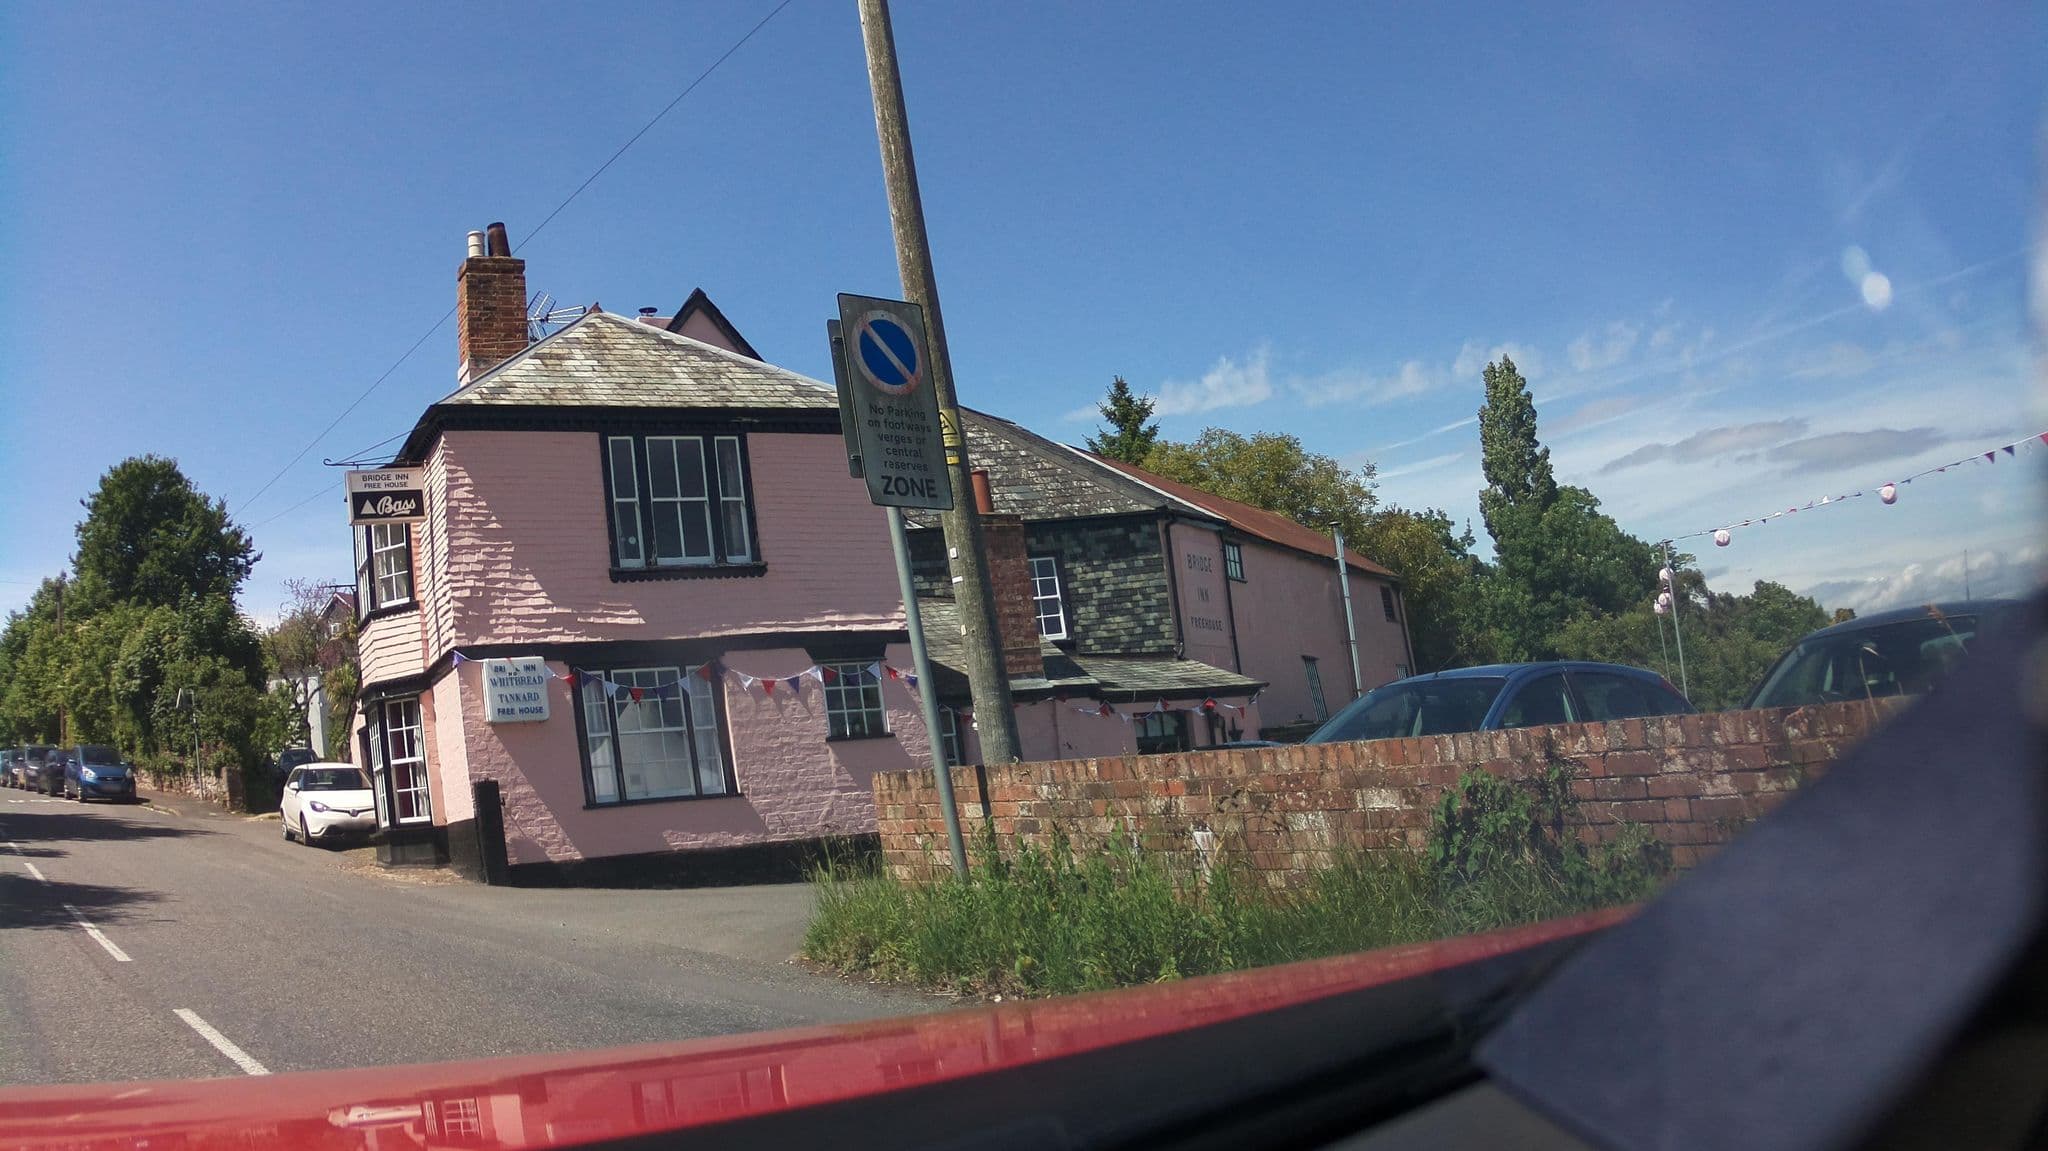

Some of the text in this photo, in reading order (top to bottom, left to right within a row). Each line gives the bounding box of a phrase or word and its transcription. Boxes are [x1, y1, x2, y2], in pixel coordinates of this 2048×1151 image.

[869, 403, 926, 421] No Parking
[868, 418, 931, 433] on footways
[879, 433, 926, 445] verges or
[886, 447, 922, 458] central
[884, 460, 928, 472] reserves
[395, 473, 409, 481] INN
[881, 475, 938, 498] ZONE
[377, 496, 416, 516] Bass
[1187, 553, 1213, 573] BRIDGE
[1197, 586, 1210, 601] INN
[523, 663, 536, 673] INN
[490, 675, 544, 688] WHITBREAD
[498, 692, 540, 704] TANKARD
[497, 706, 544, 716] FREE HOUSE
